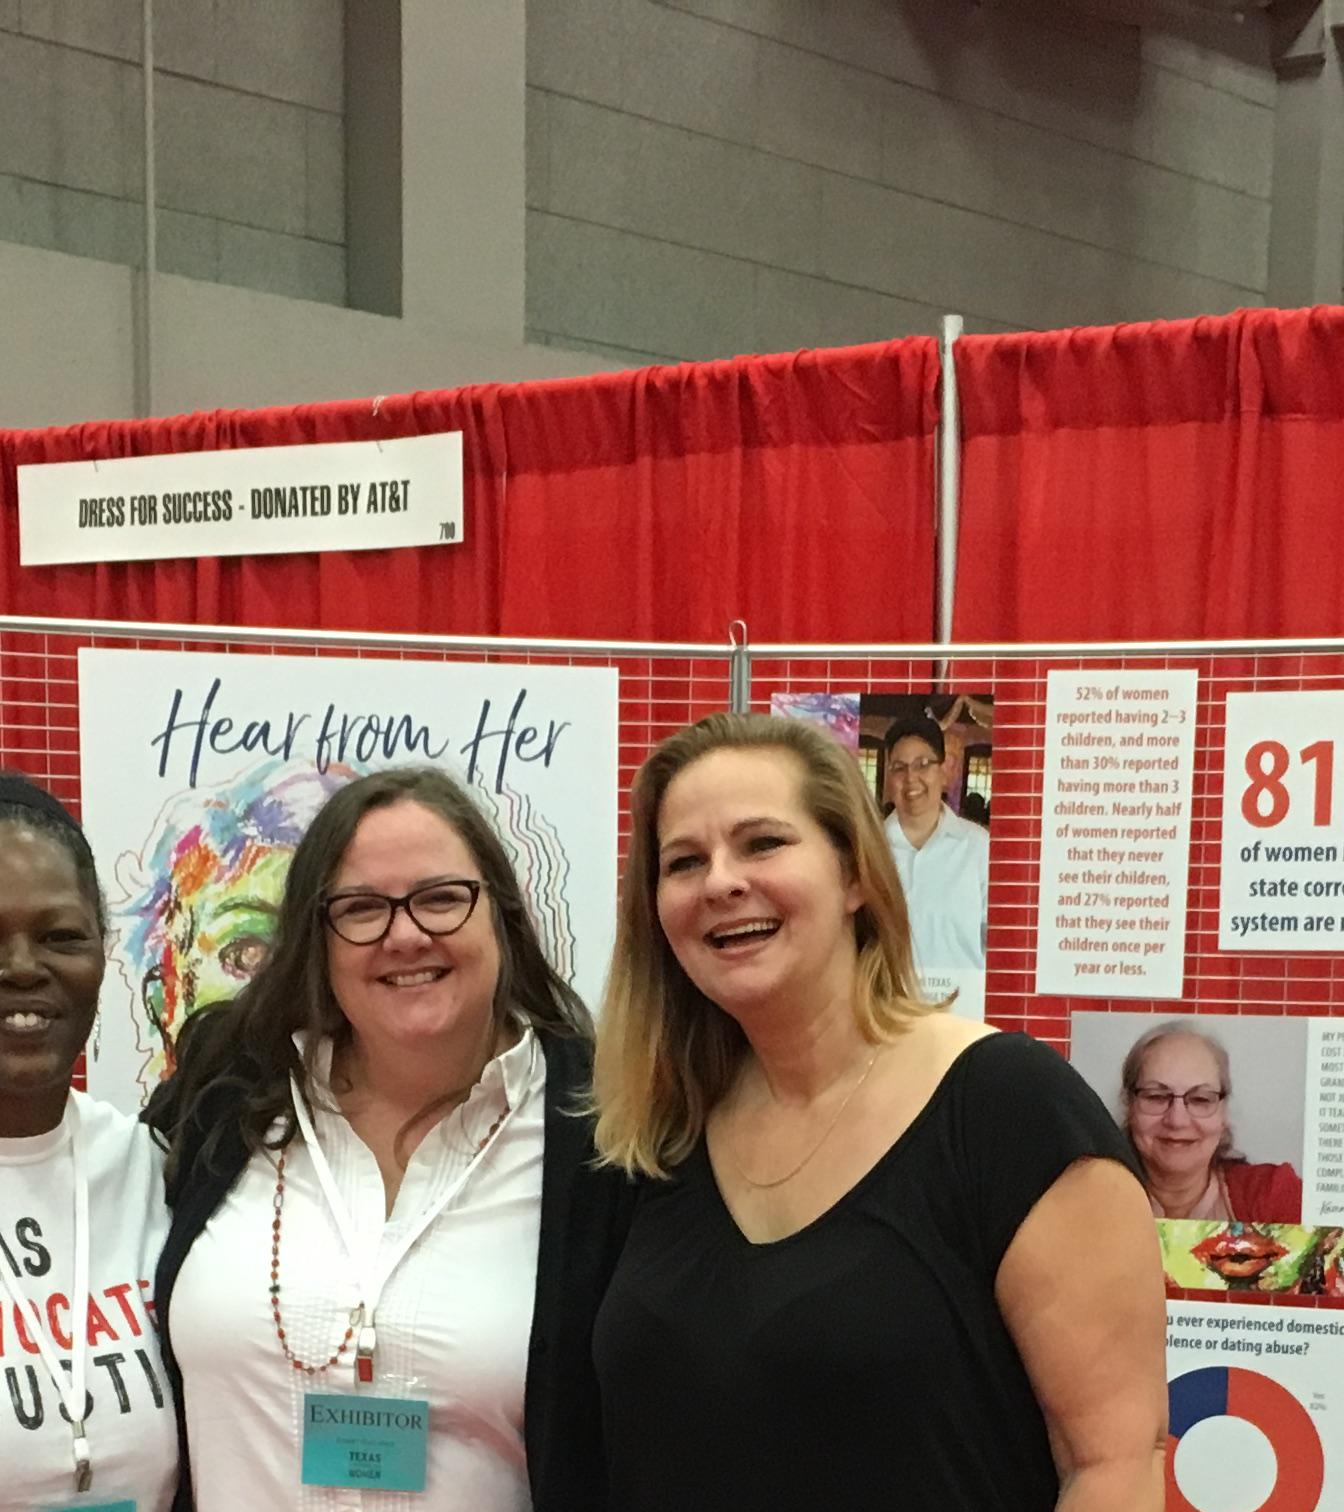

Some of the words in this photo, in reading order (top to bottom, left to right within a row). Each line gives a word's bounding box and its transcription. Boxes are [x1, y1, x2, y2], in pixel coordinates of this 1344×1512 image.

[79, 496, 125, 528] DRESS
[130, 494, 157, 525] FOR
[162, 489, 232, 524] SUCCESS
[251, 485, 330, 519] DONATED
[338, 483, 360, 515] BY
[367, 479, 410, 513] AT&T
[1076, 686, 1102, 700] 52%
[1106, 686, 1119, 700] of
[1122, 689, 1169, 700] women
[1057, 709, 1111, 725] reported
[1115, 709, 1158, 725] having
[151, 677, 313, 787] Hear
[315, 702, 450, 775] from
[460, 687, 572, 794] Her
[1061, 732, 1115, 747] children,
[1119, 733, 1143, 746] and
[1146, 736, 1179, 746] more
[1060, 756, 1089, 769] than
[1092, 756, 1119, 769] 30%
[1122, 756, 1178, 771] reported
[1057, 778, 1099, 794] having
[1103, 782, 1135, 792] more
[1139, 779, 1168, 793] than
[1171, 779, 1178, 793] 3
[1054, 801, 1107, 815] children.
[1112, 802, 1152, 818] Nearly
[1155, 802, 1181, 816] half
[1240, 840, 1261, 862] of
[1264, 846, 1336, 861] women
[1249, 878, 1298, 896] state
[1231, 913, 1298, 936] system
[1303, 916, 1334, 931] are
[1176, 1316, 1204, 1327] ever
[1206, 1316, 1283, 1331] experienced
[1286, 1319, 1344, 1335] domestic
[1205, 1339, 1218, 1349] or
[1221, 1337, 1262, 1355] dating
[1265, 1340, 1309, 1355] abuse?
[310, 1404, 421, 1429] EXHIBITOR
